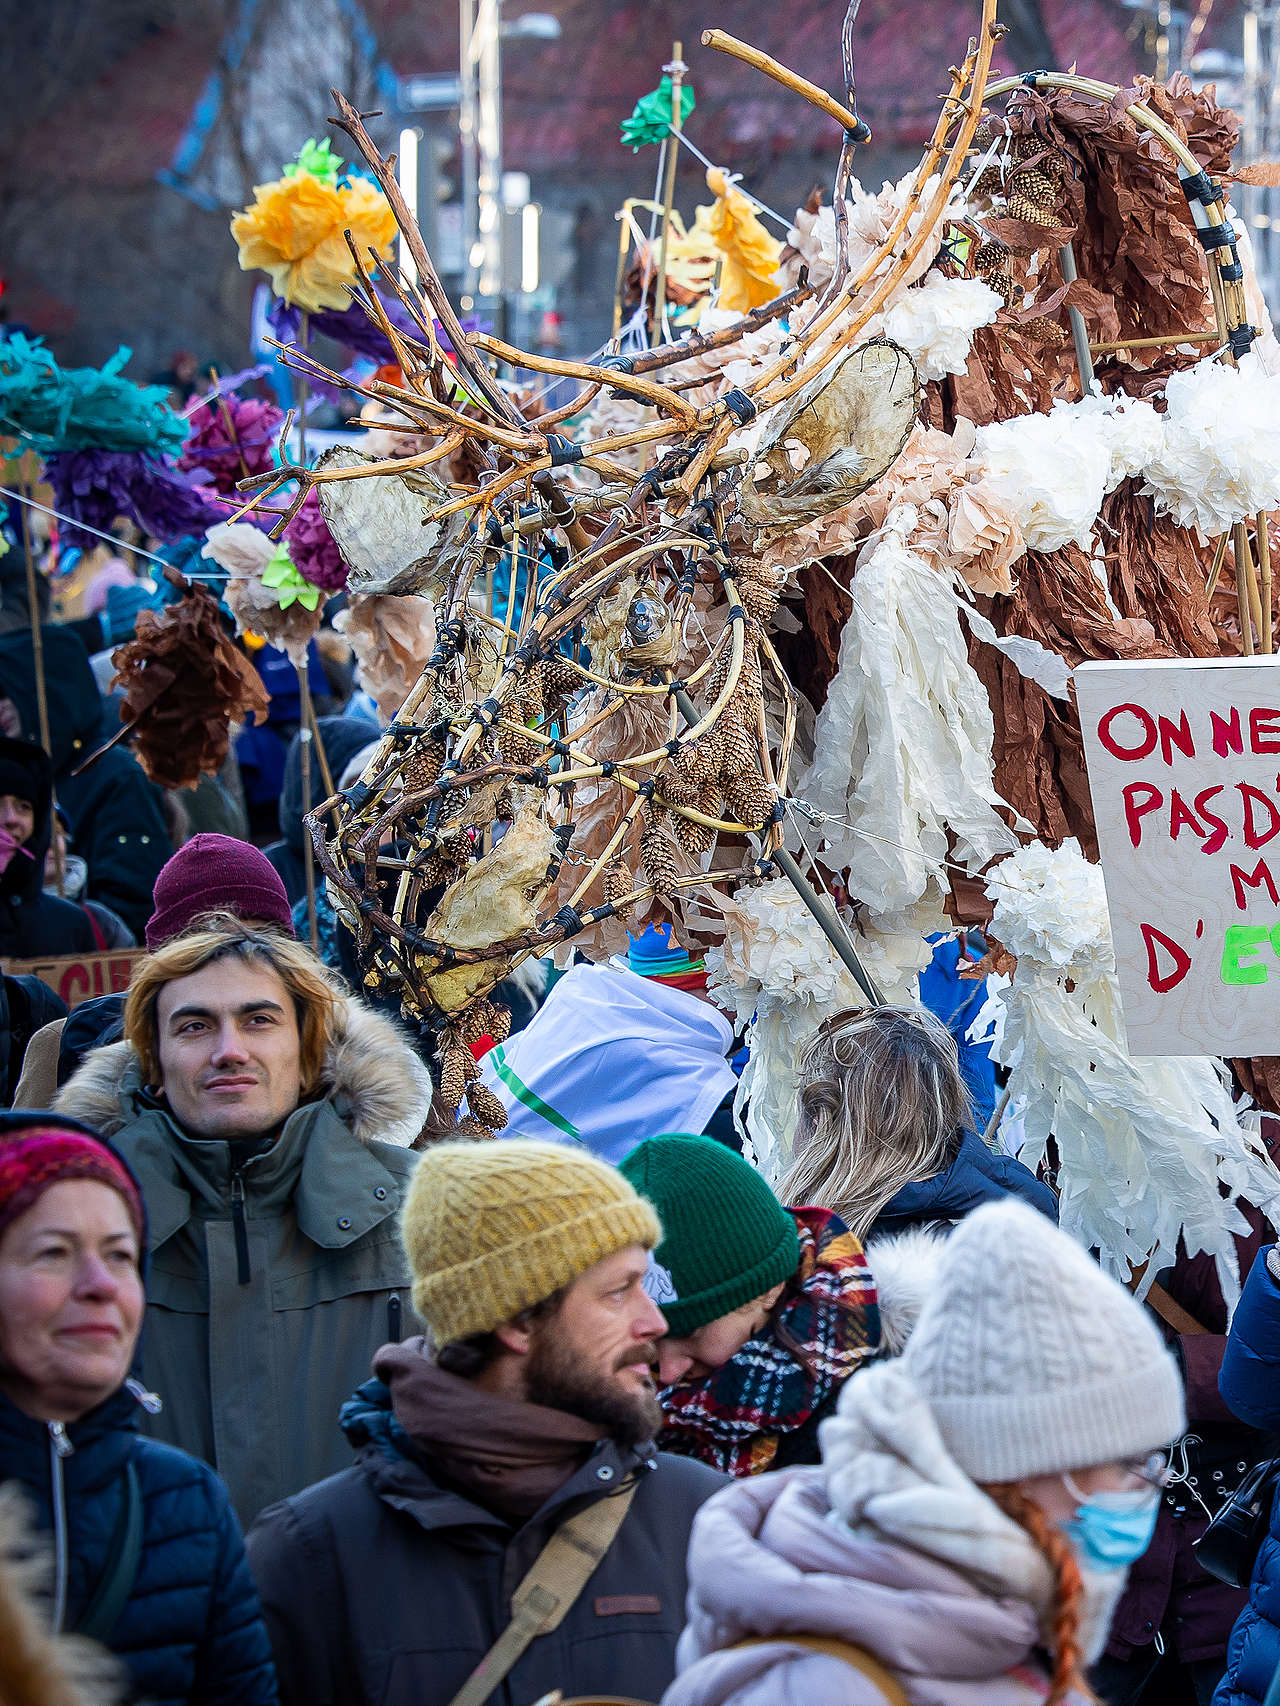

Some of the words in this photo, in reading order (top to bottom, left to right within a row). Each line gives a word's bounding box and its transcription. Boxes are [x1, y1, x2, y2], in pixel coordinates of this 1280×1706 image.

[1097, 703, 1196, 766] ON
[1123, 782, 1228, 854] PAS
[1140, 919, 1204, 994] D'
